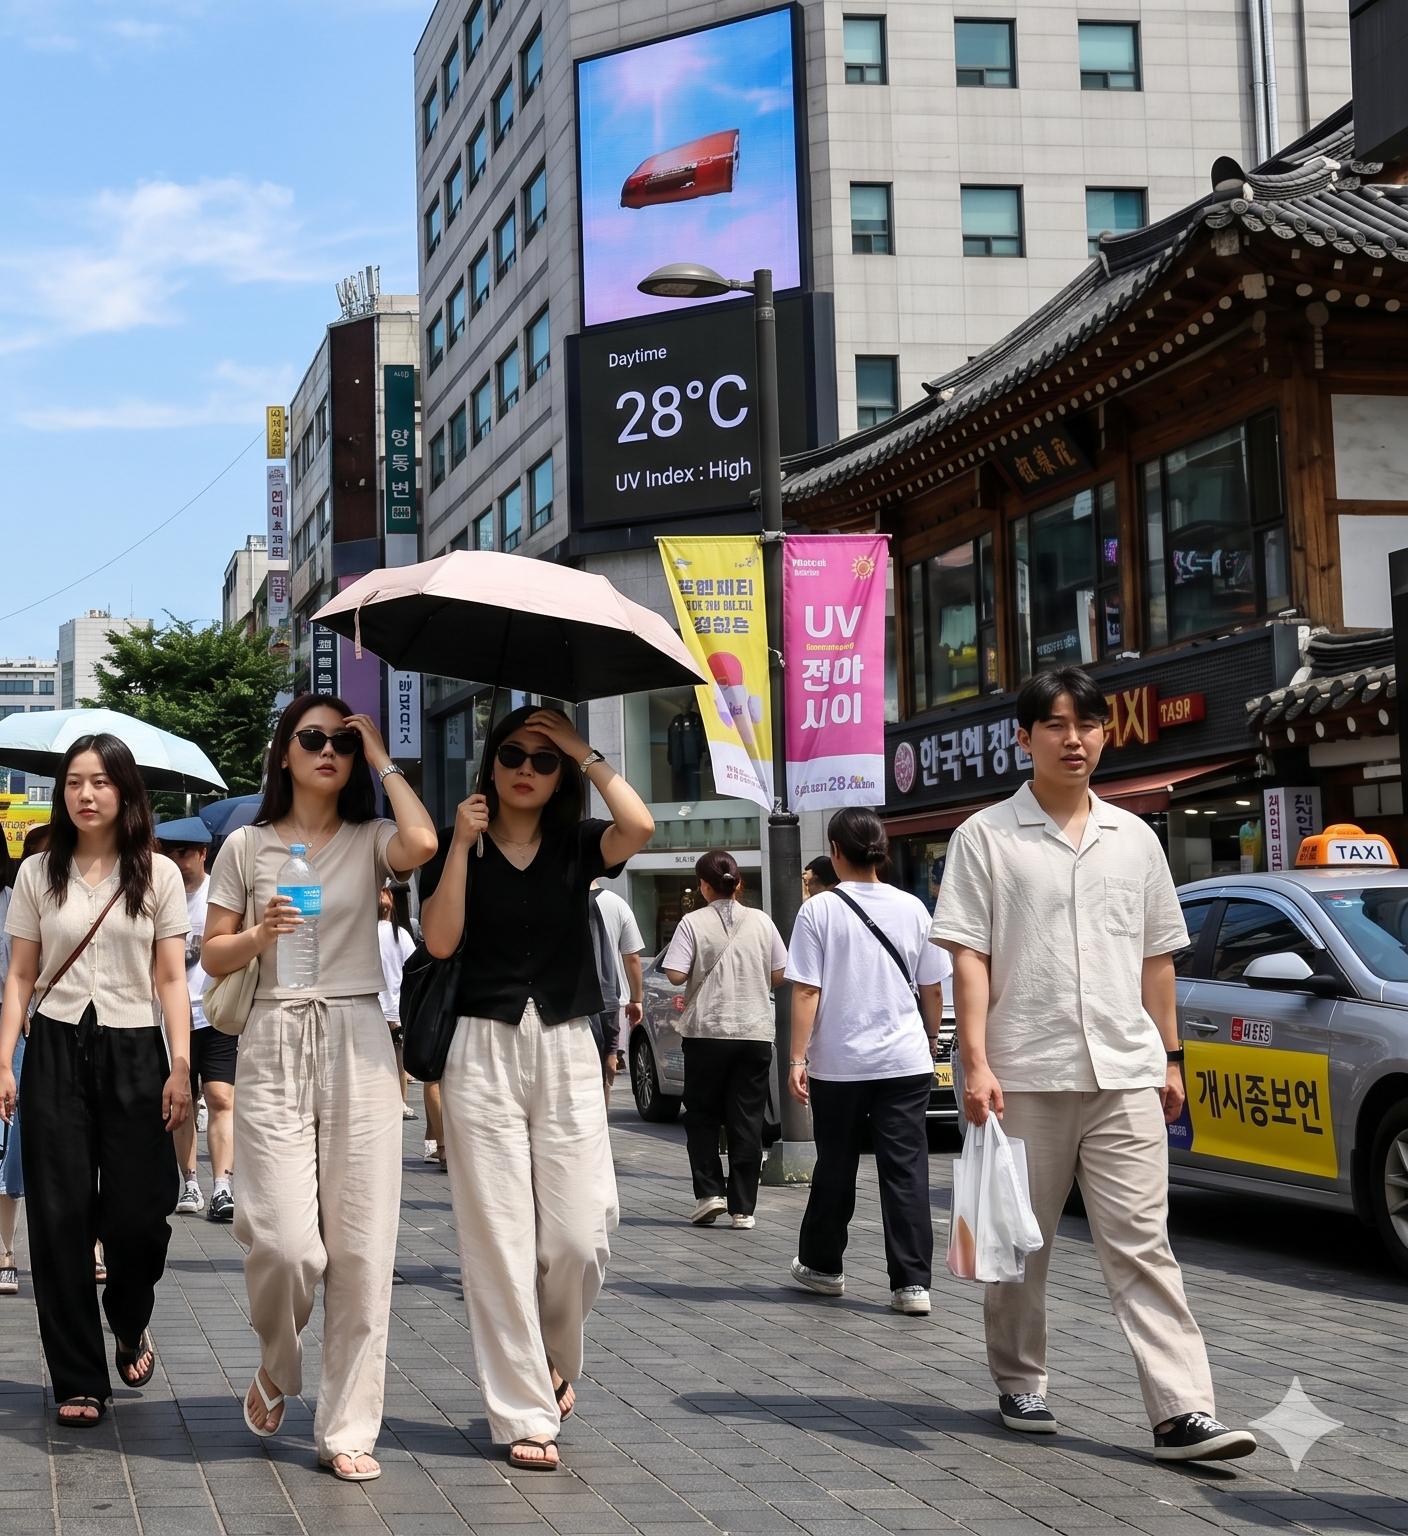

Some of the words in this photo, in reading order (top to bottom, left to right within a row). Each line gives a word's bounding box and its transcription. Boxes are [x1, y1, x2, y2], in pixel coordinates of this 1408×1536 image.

[609, 347, 667, 368] Daytime
[615, 374, 749, 444] 28°C
[615, 471, 641, 491] UV
[646, 466, 694, 488] Index
[709, 457, 751, 481] High
[804, 605, 863, 638] UV
[1335, 845, 1384, 860] TAXI
[1195, 1069, 1324, 1136] 개시종보언
